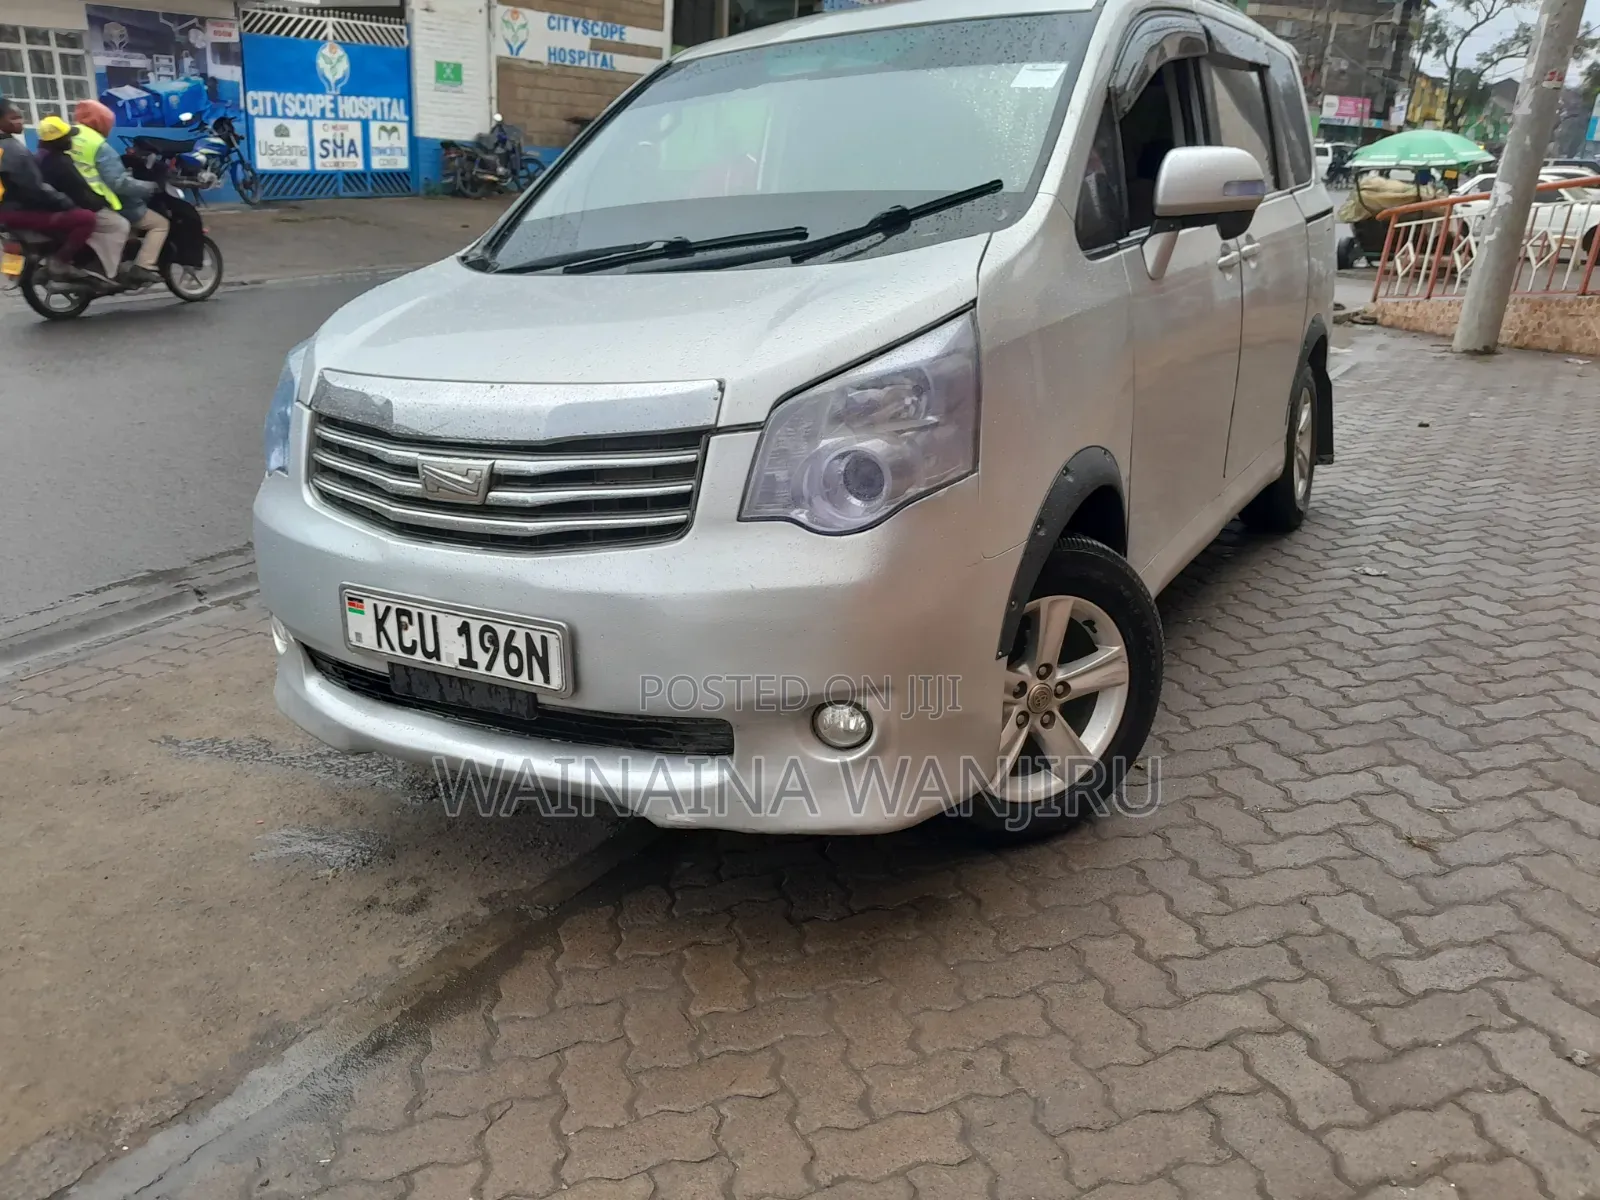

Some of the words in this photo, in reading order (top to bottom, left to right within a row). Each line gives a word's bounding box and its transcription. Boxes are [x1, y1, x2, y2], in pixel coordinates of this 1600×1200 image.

[547, 15, 627, 41] CITYSCOPE
[547, 46, 617, 70] HOSPITAL
[246, 90, 336, 119] CITYSCOPE
[338, 95, 409, 121] HOSPITAL
[258, 139, 308, 157] Usalama
[319, 133, 359, 159] SHA
[373, 602, 442, 662] KCU
[457, 619, 551, 685] 196N
